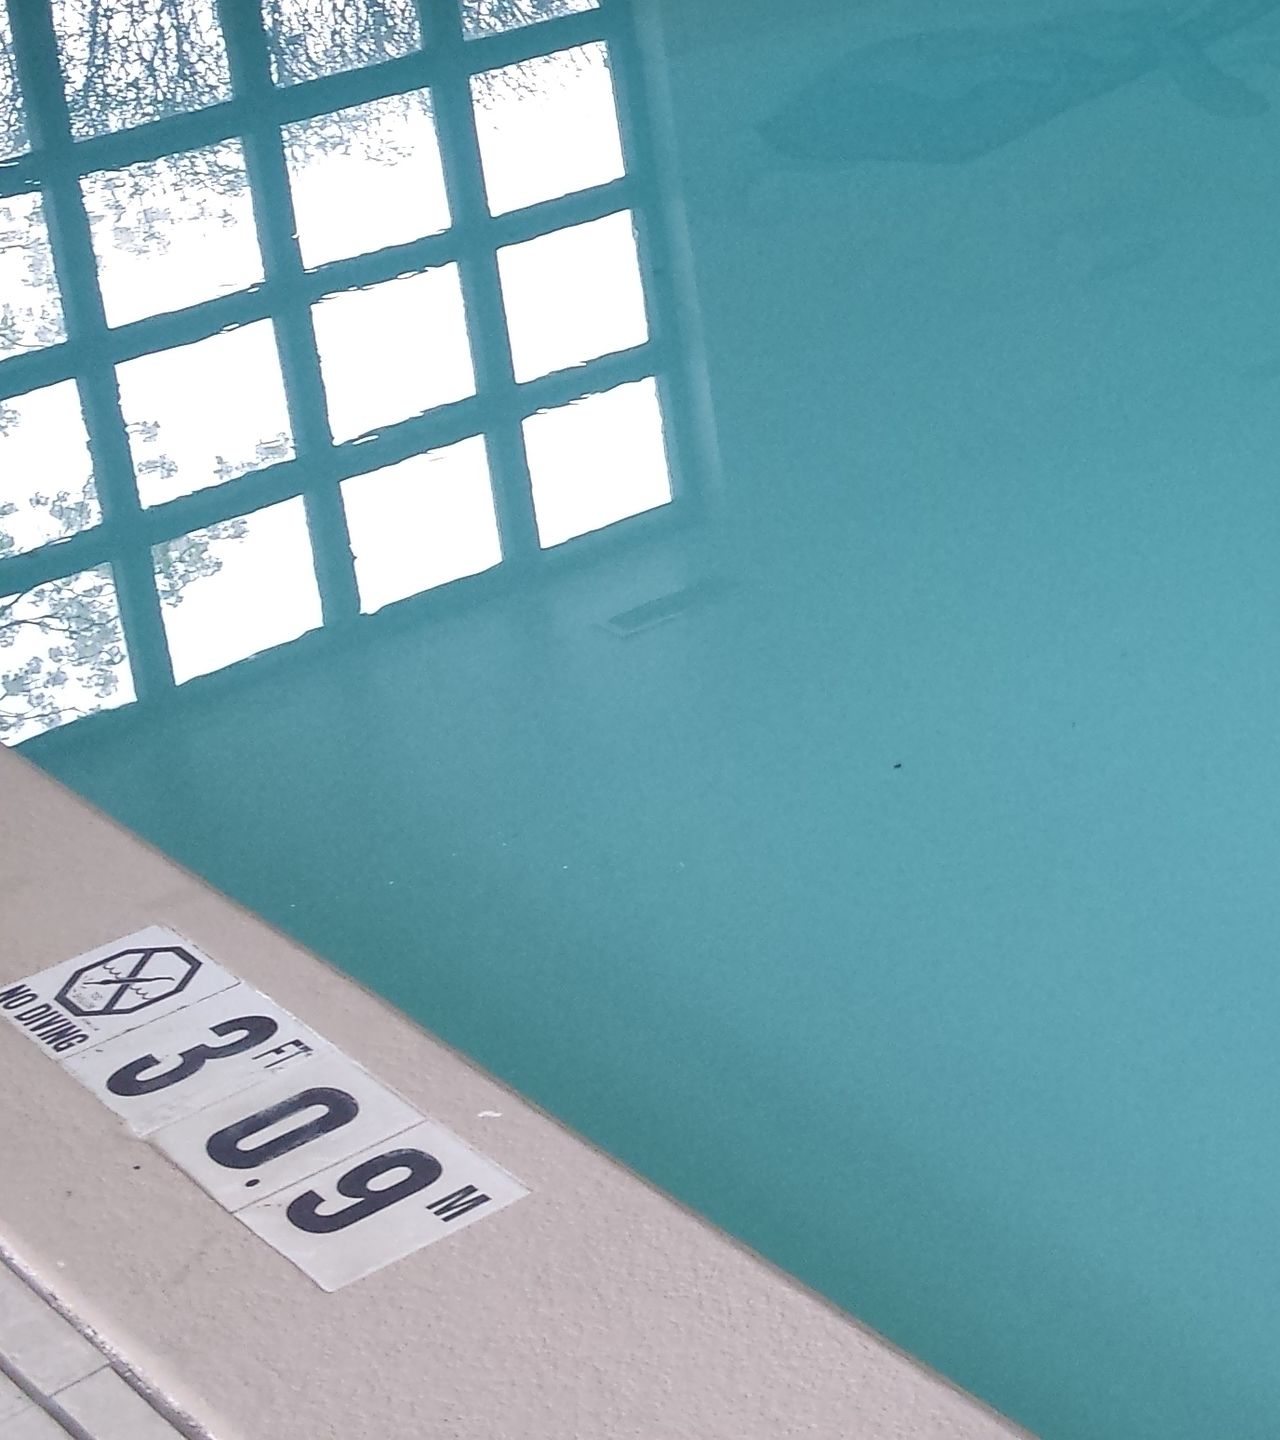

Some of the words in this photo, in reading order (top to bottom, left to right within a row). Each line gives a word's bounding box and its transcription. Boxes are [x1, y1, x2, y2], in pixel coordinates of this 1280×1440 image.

[0, 984, 39, 1010] NO
[14, 1003, 90, 1053] DIVING
[106, 1015, 280, 1097] 3
[425, 1184, 494, 1223] M
